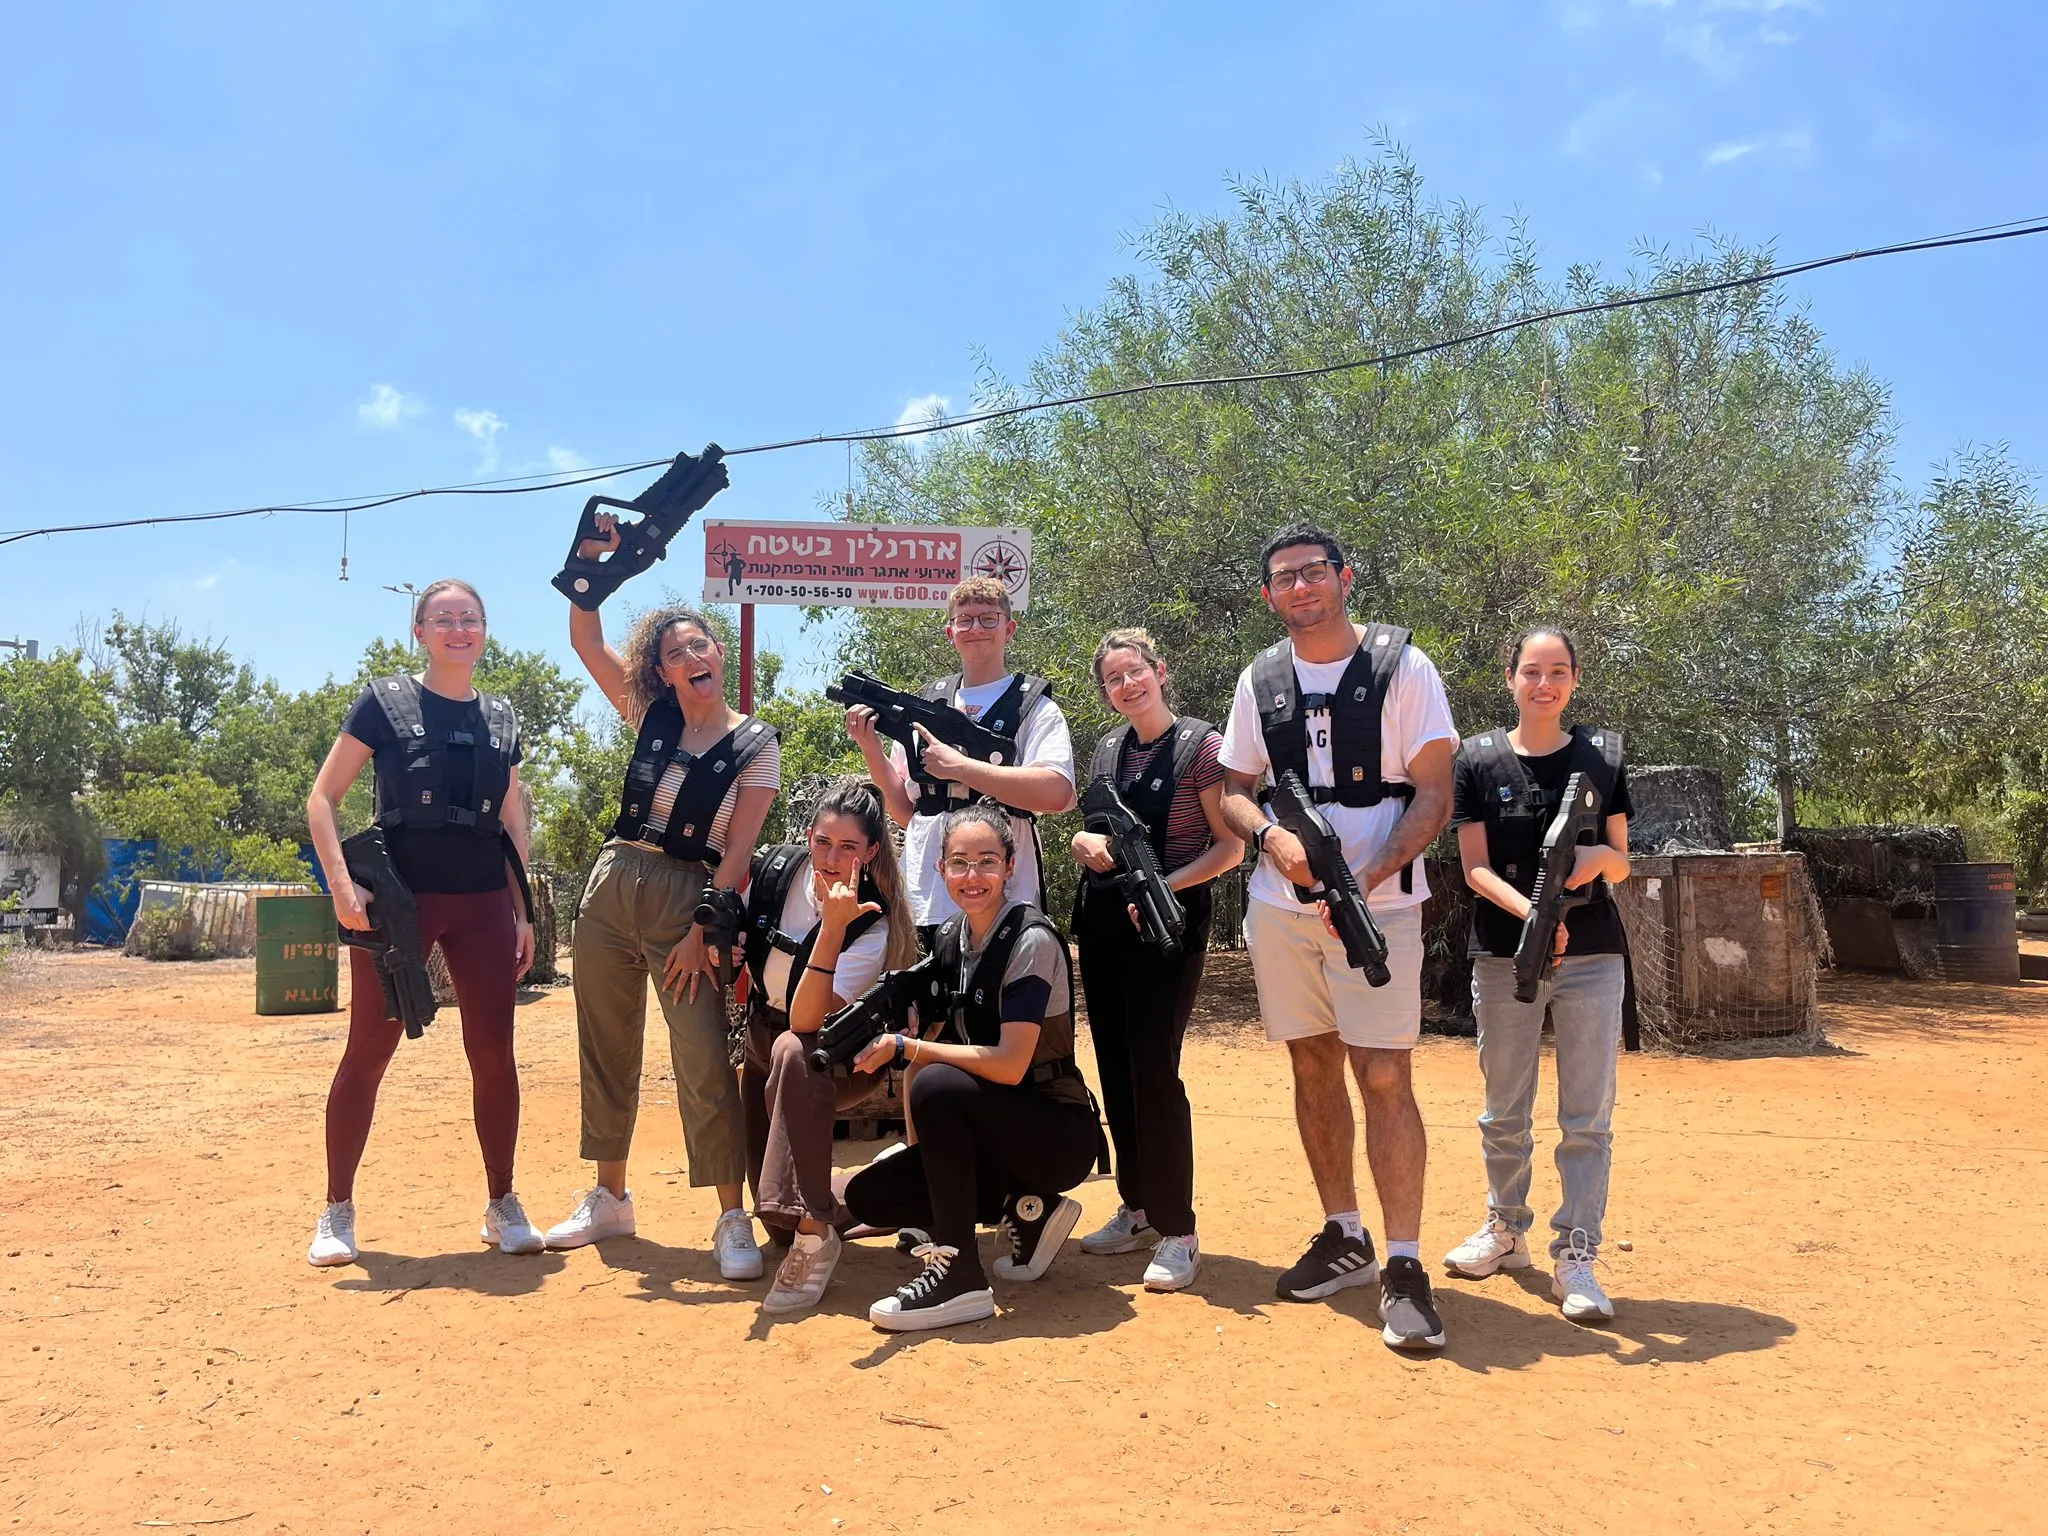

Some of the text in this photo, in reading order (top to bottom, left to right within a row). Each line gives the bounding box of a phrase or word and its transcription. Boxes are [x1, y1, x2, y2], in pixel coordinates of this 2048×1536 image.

[747, 533, 957, 564] אדרנלין בשטח
[747, 563, 957, 579] אירועי אתגר חוויה והרפתקנות
[746, 584, 853, 599] 1-700-50-56-50
